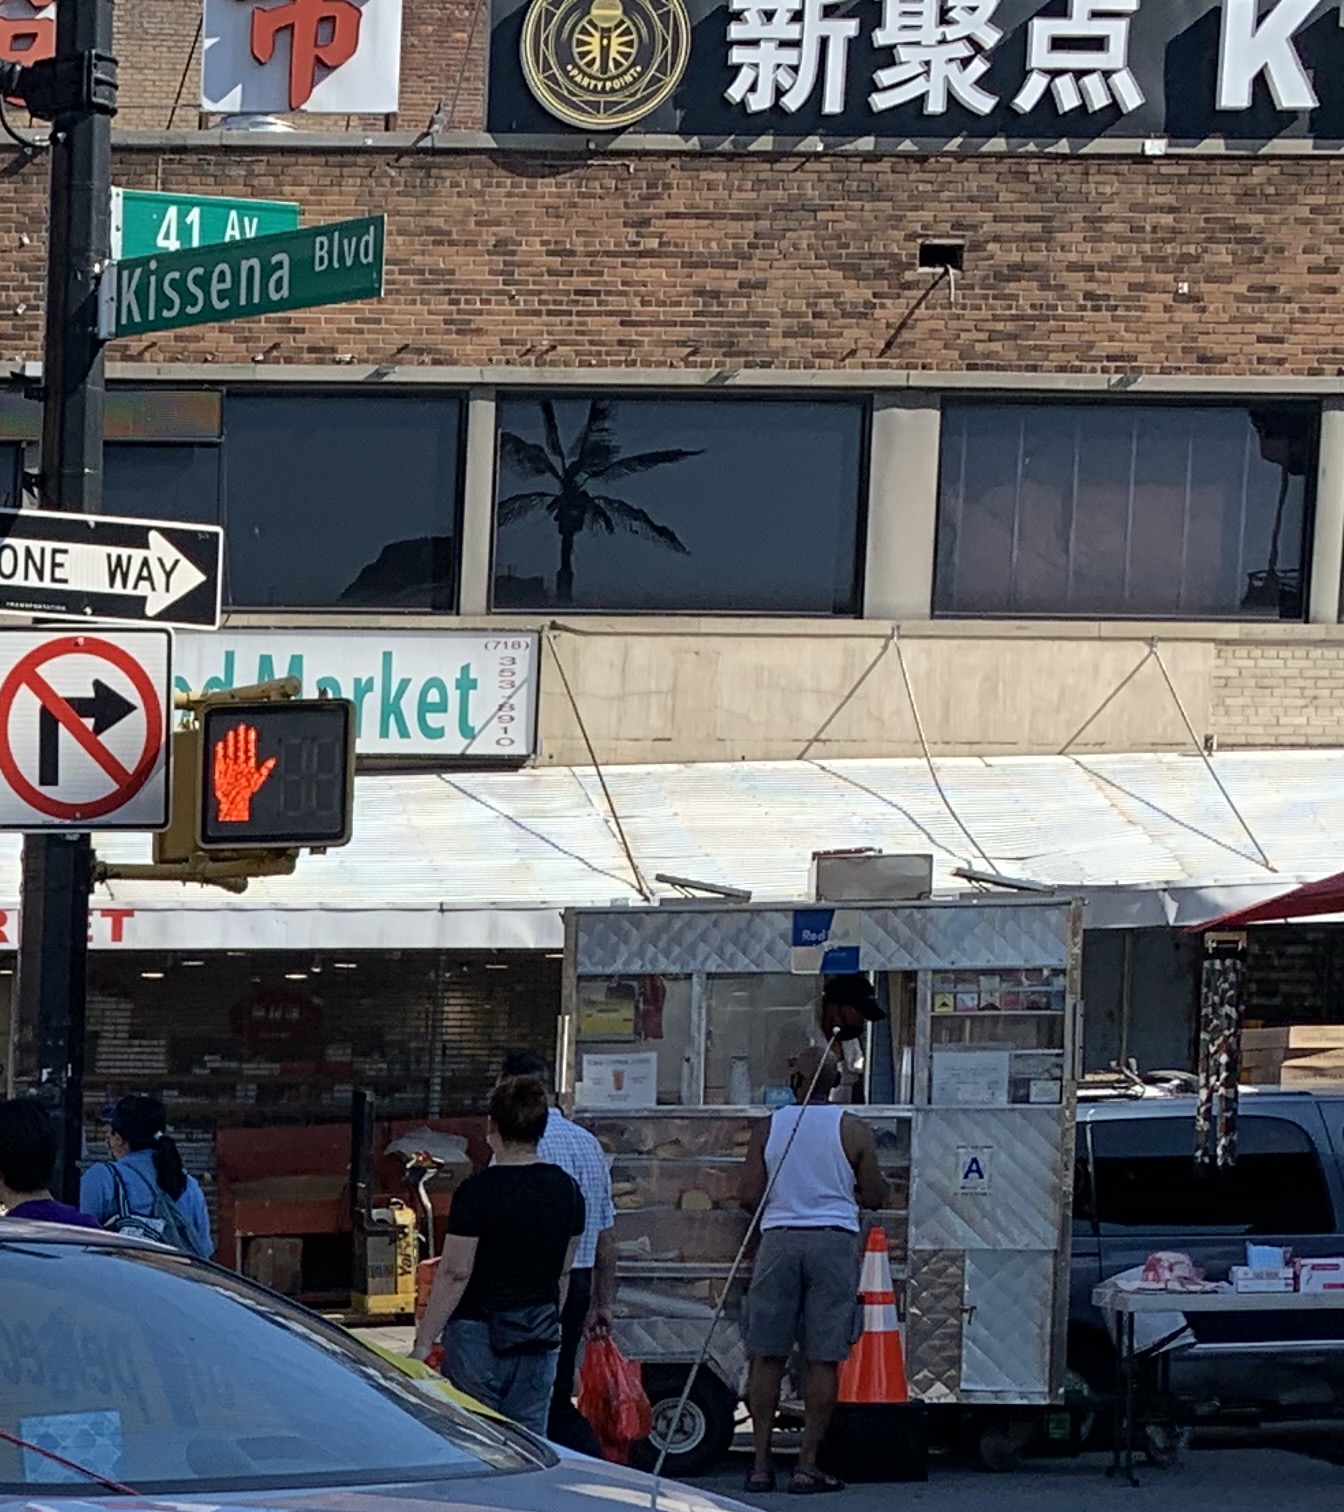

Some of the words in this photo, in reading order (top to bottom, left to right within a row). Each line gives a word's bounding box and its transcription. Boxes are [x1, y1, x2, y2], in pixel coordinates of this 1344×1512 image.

[569, 67, 604, 91] PARTY
[605, 68, 640, 91] POINT
[724, 0, 1145, 116] 新聚点
[156, 205, 201, 251] 41
[225, 209, 259, 243] Av
[120, 251, 291, 326] Kissena
[314, 225, 375, 272] Blvd
[106, 552, 181, 593] WAY
[963, 1156, 985, 1180] A
